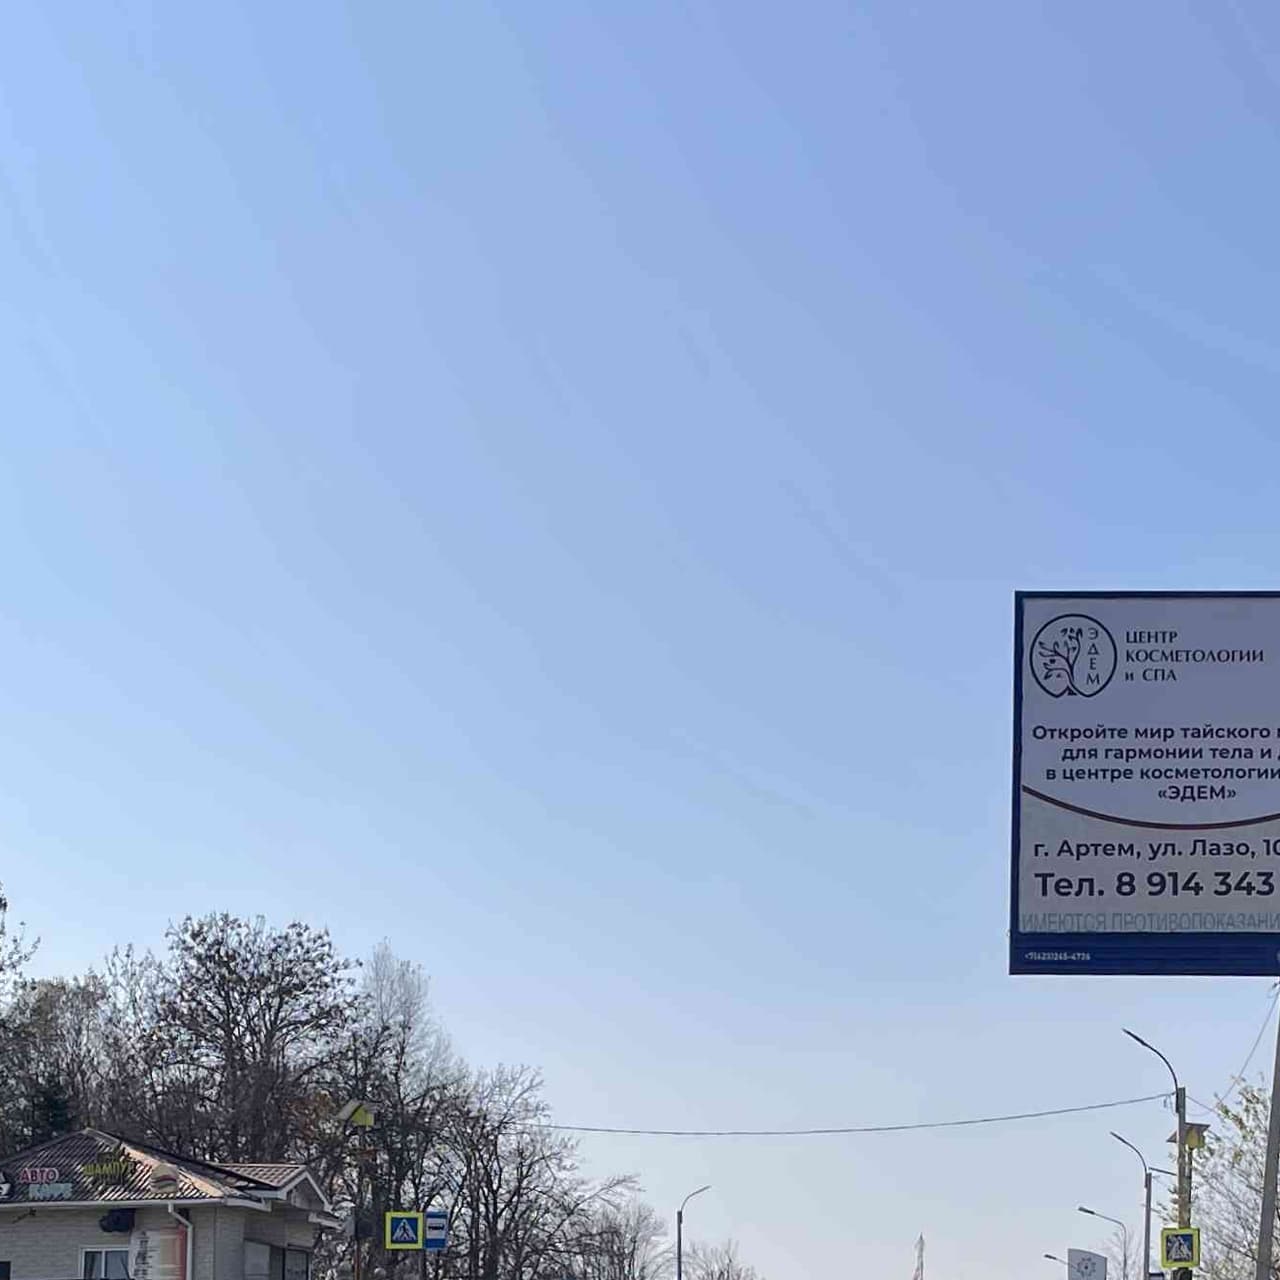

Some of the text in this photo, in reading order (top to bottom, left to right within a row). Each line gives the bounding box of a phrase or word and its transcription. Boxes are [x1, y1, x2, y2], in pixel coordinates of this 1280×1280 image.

[1125, 631, 1178, 644] ЦЕНТР
[1086, 627, 1101, 685] ЭДЕМ
[1125, 649, 1265, 663] КОСМЕТОЛОГИИ
[1125, 668, 1177, 682] и СПА
[1032, 725, 1129, 743] Откройте
[1134, 729, 1174, 743] мир
[1180, 725, 1271, 740] тайского
[1061, 747, 1098, 761] для
[1104, 747, 1202, 763] гармонии
[1210, 747, 1254, 759] тела
[1260, 747, 1272, 759] и
[1045, 768, 1056, 780] в
[1062, 768, 1133, 783] центре
[1157, 785, 1237, 802] «ЭДЕМ»
[1034, 843, 1049, 857] г.
[1057, 840, 1141, 861] Артем,
[1148, 843, 1182, 861] ул.
[1189, 839, 1256, 860] Лазо,
[1034, 872, 1105, 898] Тел.
[1115, 871, 1136, 898] 8
[1146, 871, 1204, 897] 914
[1212, 871, 1275, 897] 343
[1021, 912, 1107, 931] ИМЕЮТСЯ
[20, 1168, 59, 1184] АВТО
